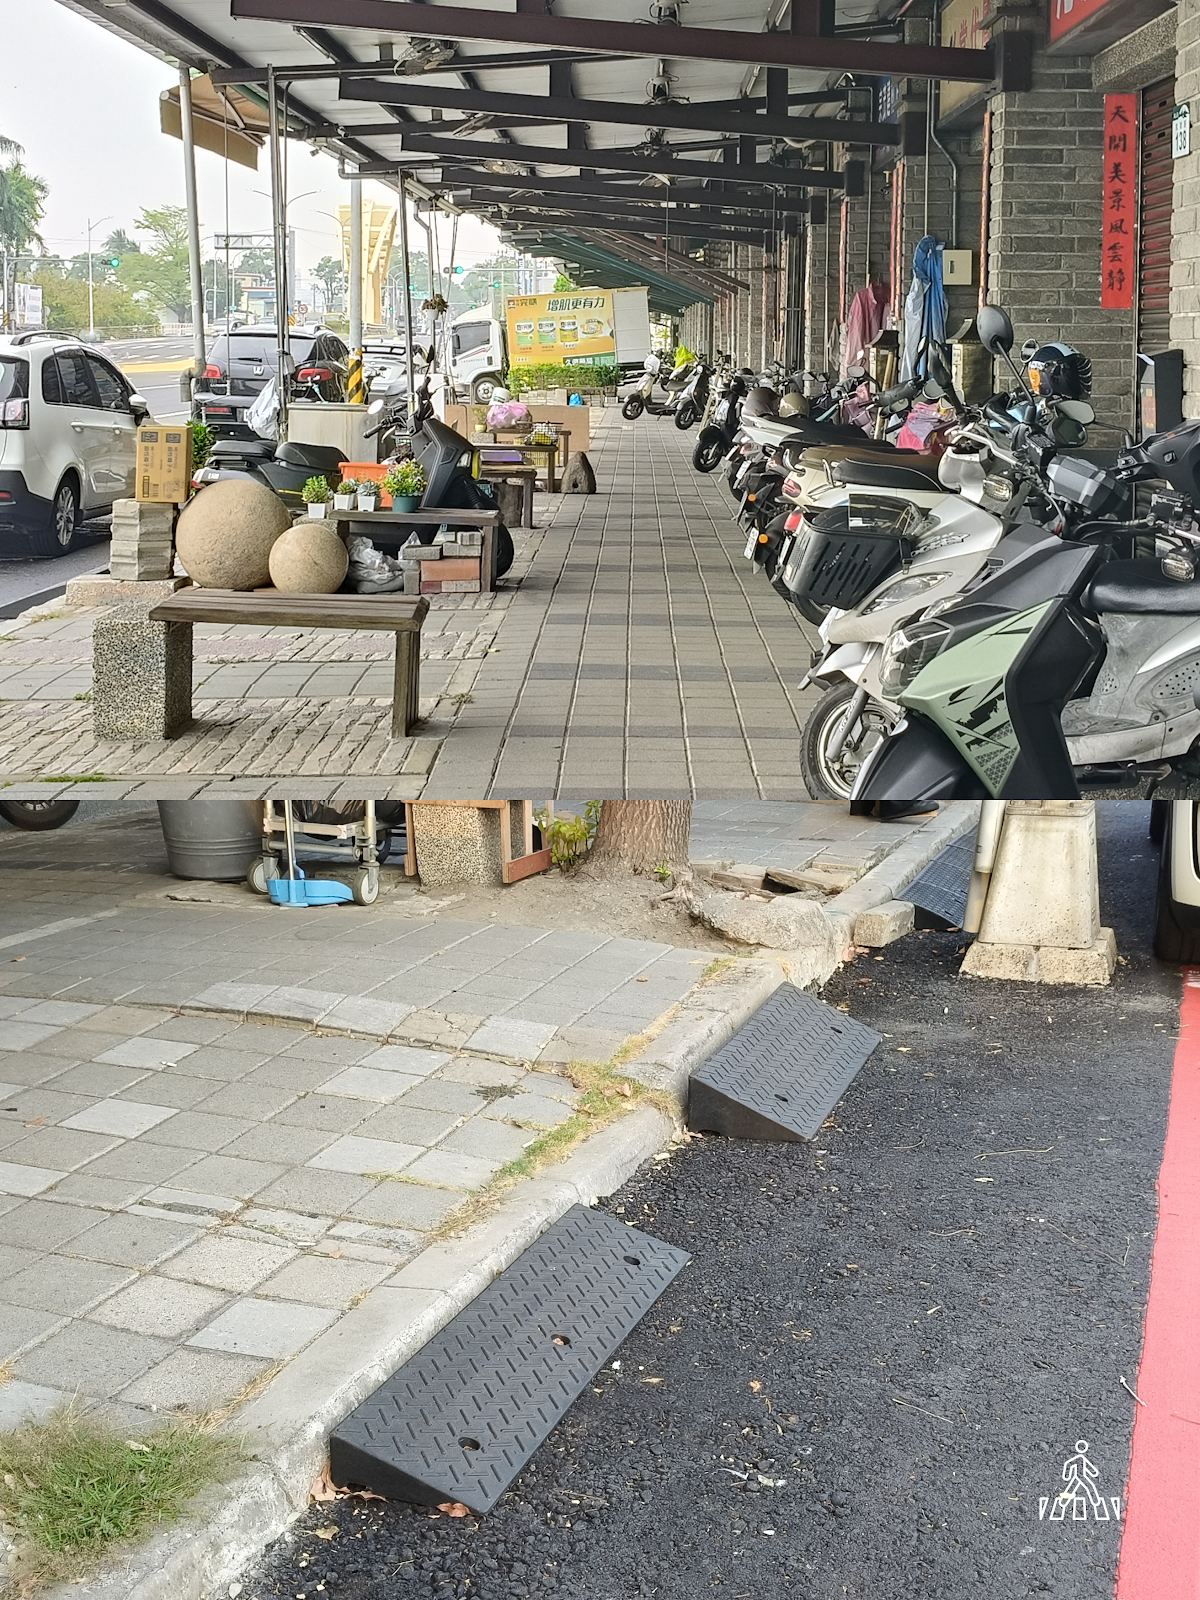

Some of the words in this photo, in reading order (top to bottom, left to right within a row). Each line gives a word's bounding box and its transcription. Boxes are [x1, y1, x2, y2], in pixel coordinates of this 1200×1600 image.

[1175, 130, 1187, 152] 138
[547, 297, 604, 311] 增肌更有力
